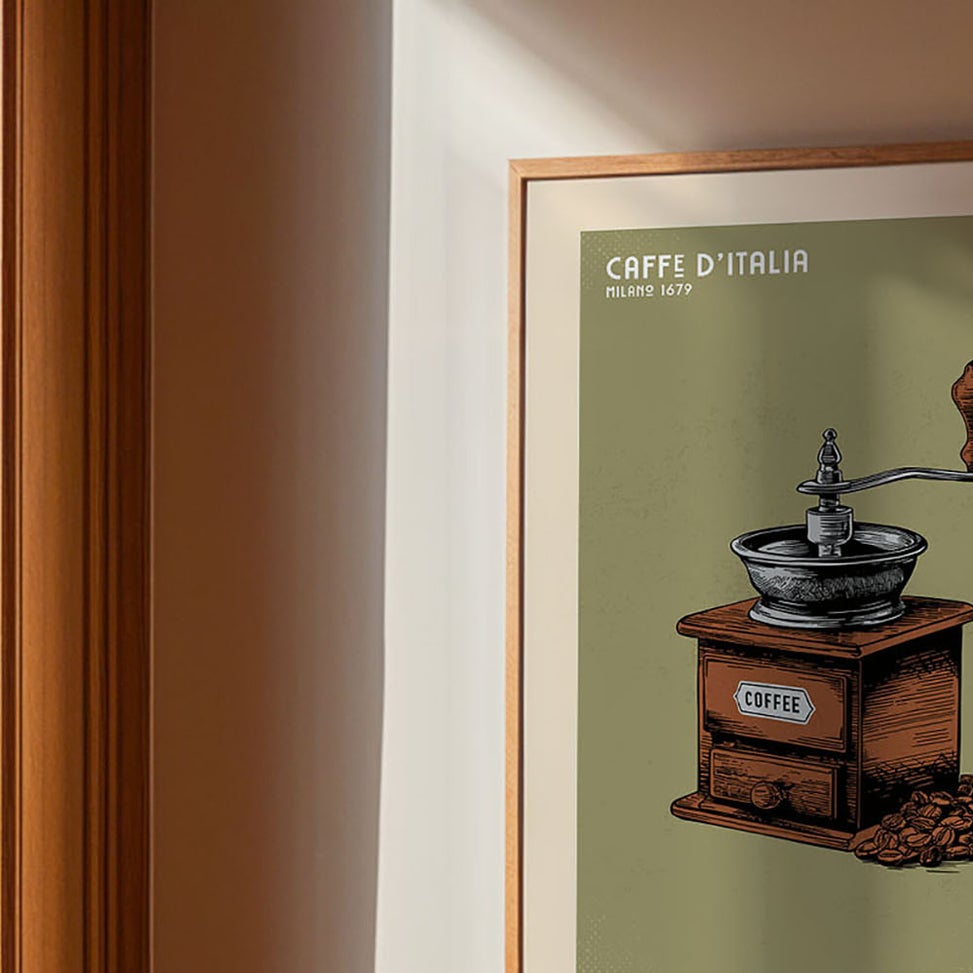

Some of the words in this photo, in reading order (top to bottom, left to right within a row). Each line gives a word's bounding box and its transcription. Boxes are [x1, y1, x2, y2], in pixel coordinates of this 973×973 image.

[606, 254, 684, 280] CAFFE
[606, 284, 654, 298] MILANO
[661, 283, 692, 297] 1679
[745, 691, 800, 713] COFFEE
